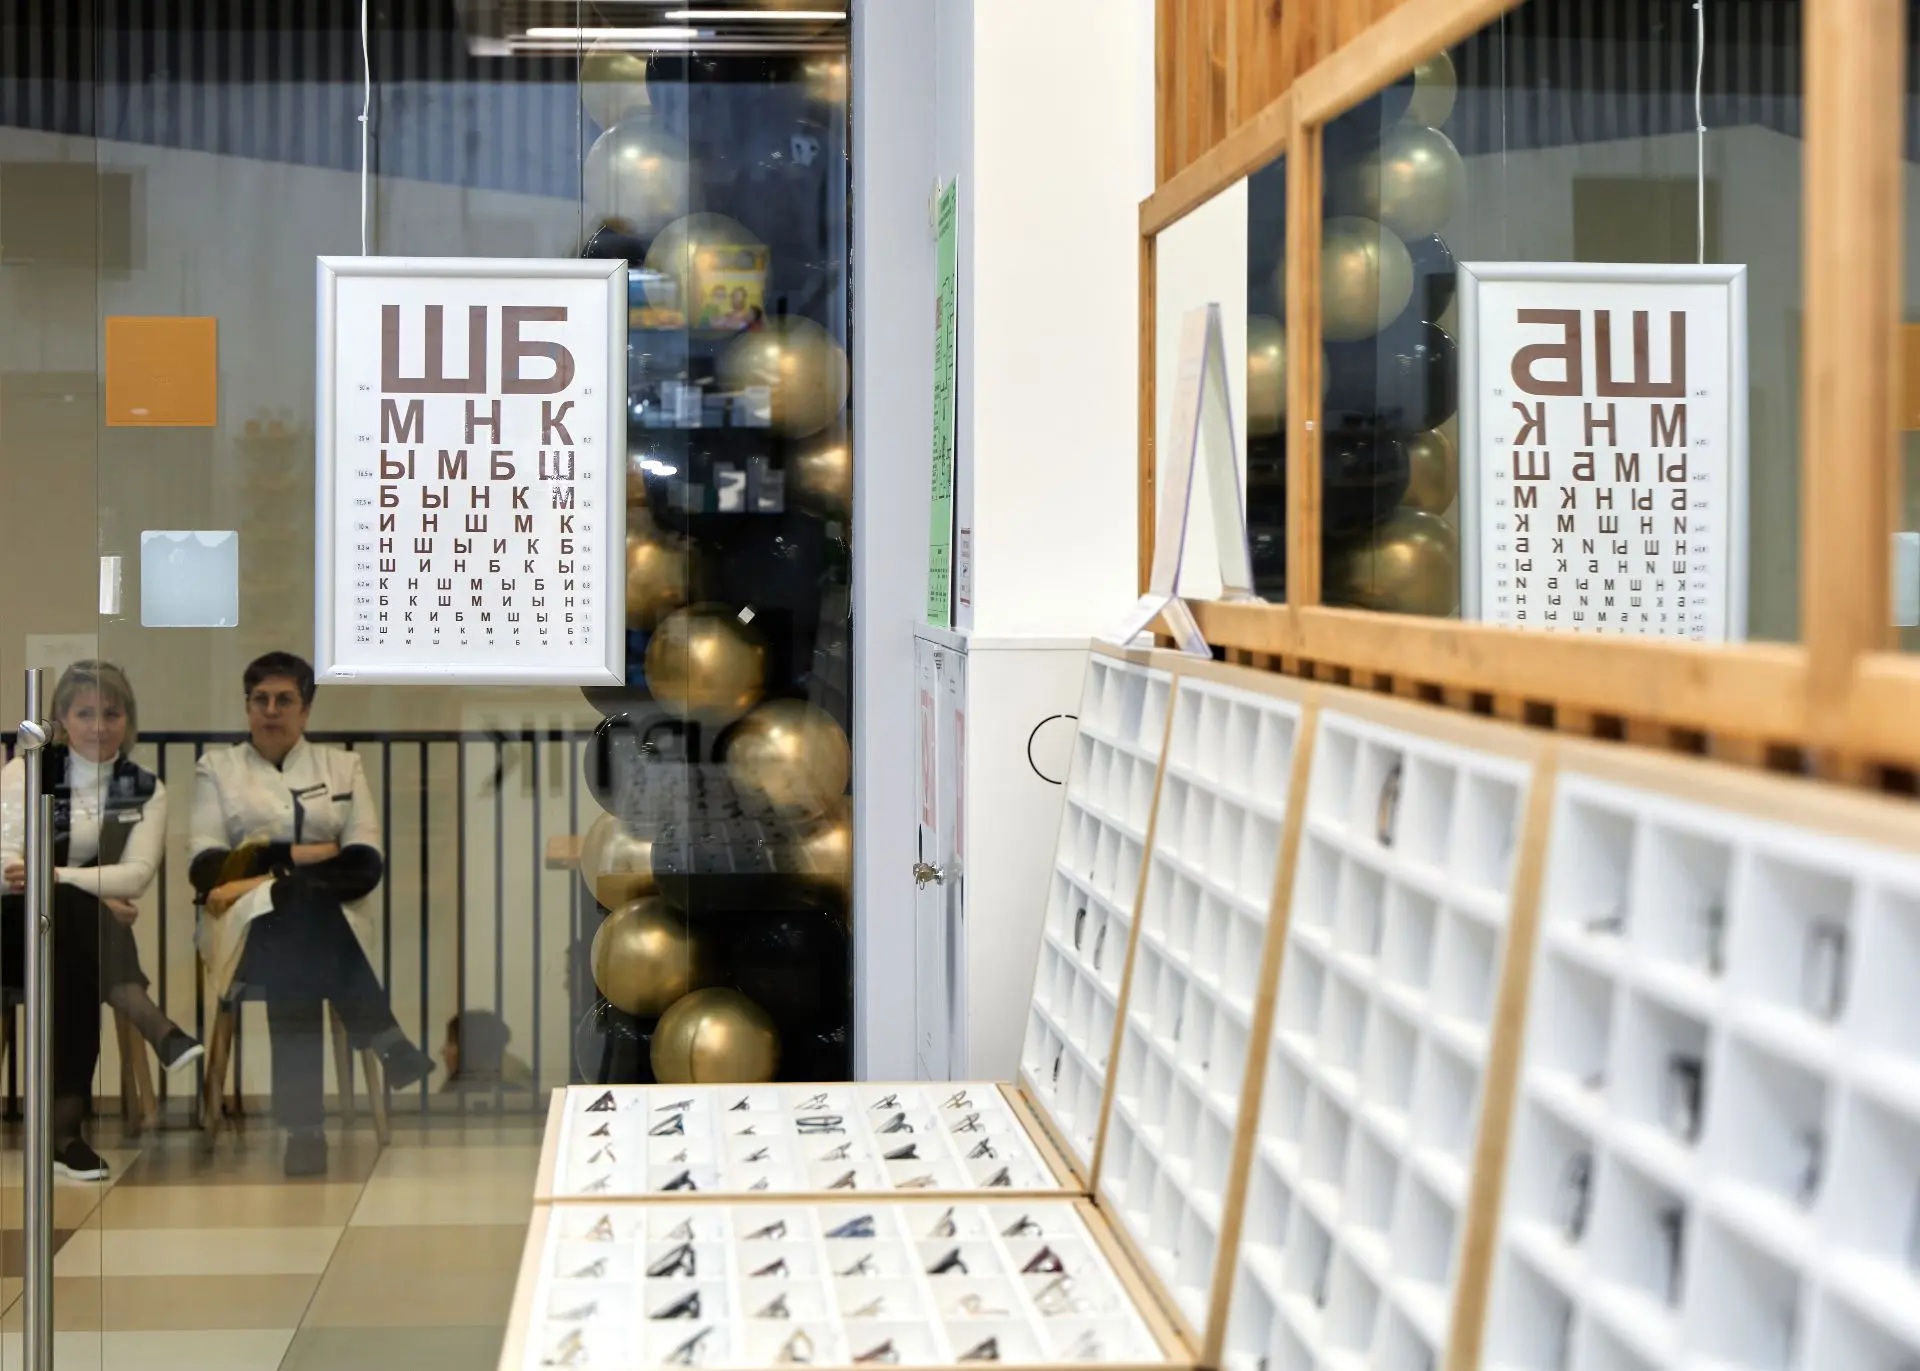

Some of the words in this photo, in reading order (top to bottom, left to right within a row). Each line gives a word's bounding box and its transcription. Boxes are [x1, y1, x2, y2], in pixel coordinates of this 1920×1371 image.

[381, 304, 575, 394] ШБ
[381, 399, 424, 444] М
[465, 400, 501, 444] Н
[542, 401, 574, 445] К
[380, 449, 415, 479] Ы
[438, 450, 467, 480] М
[491, 450, 515, 480] Б
[539, 451, 574, 480] Ш
[380, 485, 399, 508] Б
[422, 486, 448, 508] Ы
[471, 486, 489, 508] Н
[513, 486, 529, 509] К
[552, 487, 574, 509] М
[380, 514, 395, 532] И
[423, 514, 437, 532] Н
[465, 514, 487, 532] Ш
[515, 515, 532, 533] М
[561, 515, 574, 533] К
[380, 538, 392, 553] Н
[414, 538, 432, 553] Ш
[454, 538, 472, 553] Ы
[494, 539, 506, 554] И
[528, 539, 539, 554] К
[561, 539, 574, 554] Б
[380, 559, 395, 572] Ш
[420, 559, 430, 572] И
[454, 559, 465, 572] Н
[489, 560, 500, 573] Б
[525, 560, 534, 573] К
[559, 560, 573, 573] Ы
[380, 578, 388, 589] К
[408, 578, 418, 590] Н
[438, 578, 451, 590] Ш
[471, 578, 482, 590] М
[502, 579, 515, 590] Ы
[535, 579, 544, 590] Б
[564, 579, 573, 590] И
[380, 596, 388, 606] Б
[410, 596, 417, 606] К
[438, 596, 451, 606] Ш
[472, 596, 482, 606] М
[503, 596, 511, 606] И
[532, 596, 544, 606] Ы
[565, 597, 573, 607] Н
[380, 612, 387, 621] Н
[405, 612, 412, 621] К
[430, 612, 438, 621] И
[456, 612, 463, 621] Б
[481, 612, 490, 622] М
[508, 612, 519, 622] Ш
[537, 613, 548, 622] Ы
[566, 613, 573, 622] Б
